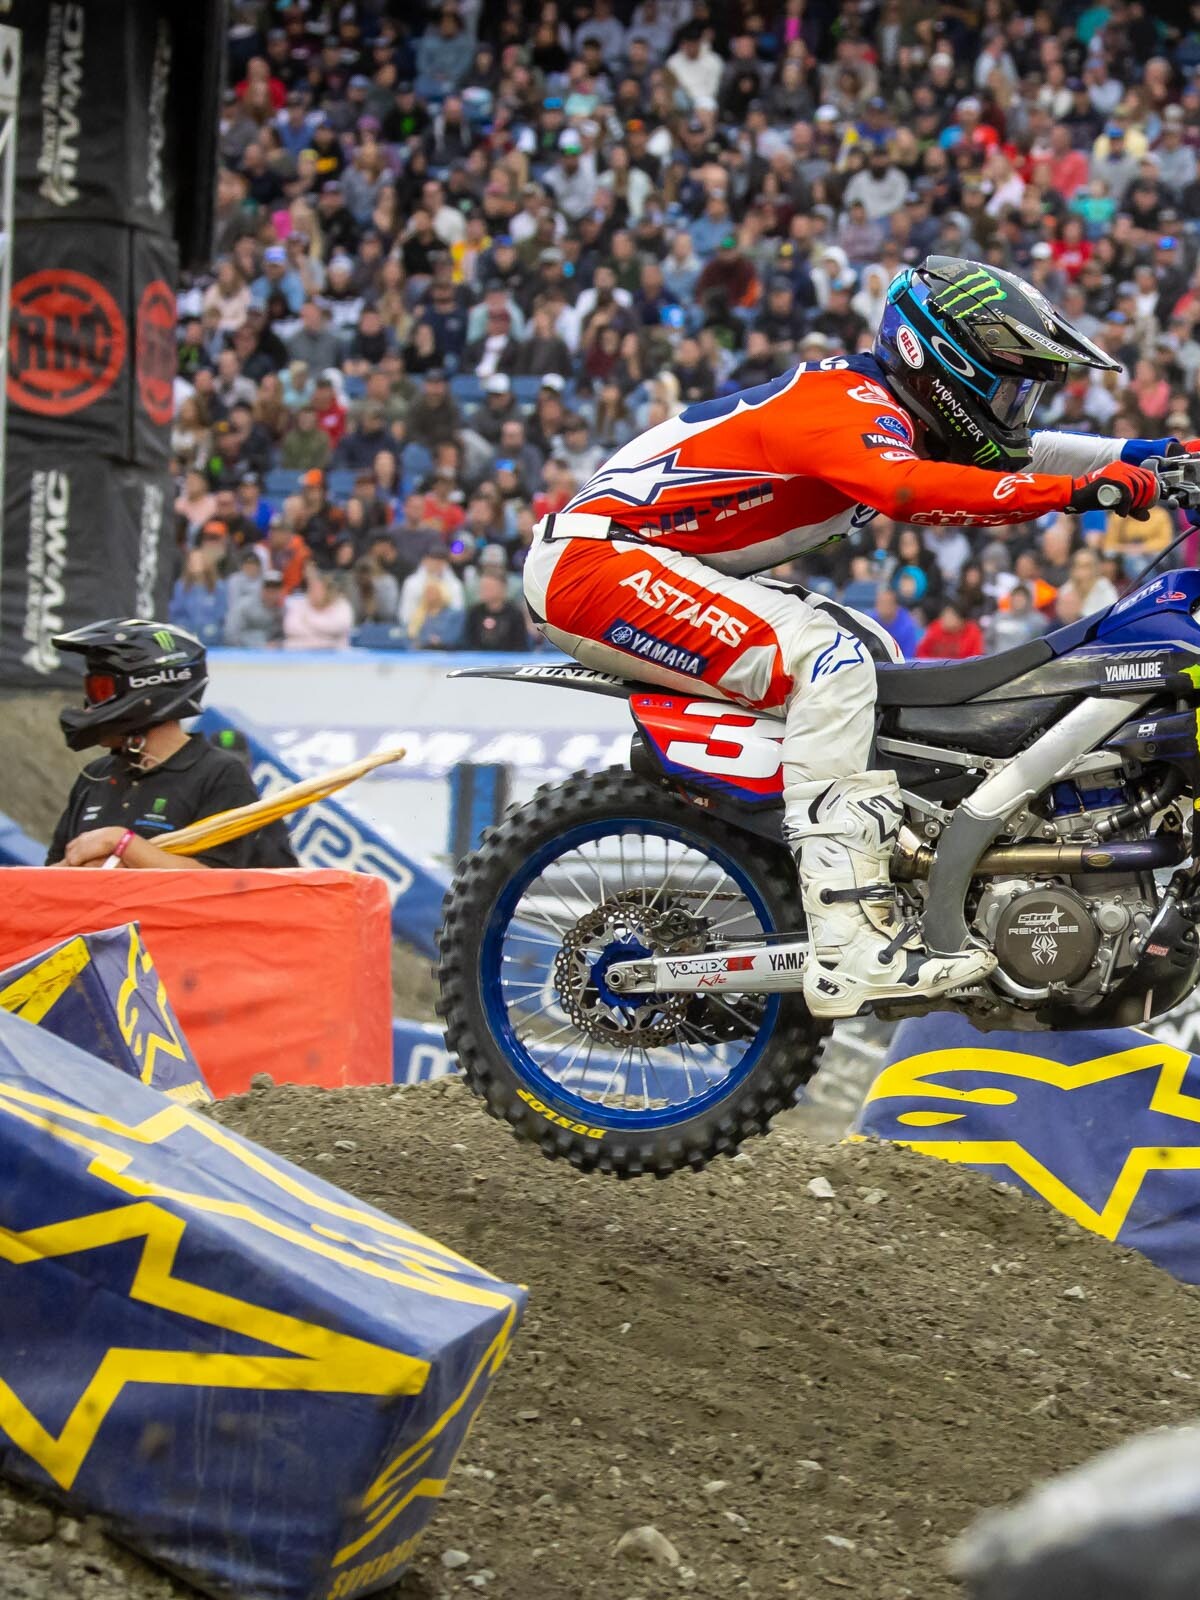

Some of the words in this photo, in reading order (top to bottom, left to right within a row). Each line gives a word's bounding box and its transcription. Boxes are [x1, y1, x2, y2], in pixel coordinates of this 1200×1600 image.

[899, 331, 919, 364] BELL
[931, 395, 967, 438] ENERGY
[618, 569, 749, 648] ASTARS
[630, 633, 700, 674] YAMAHA
[129, 667, 192, 688] bollé
[1104, 661, 1162, 683] YAMALUBE
[665, 702, 786, 780] 3
[1008, 925, 1079, 935] REKLUSE
[666, 958, 728, 978] VORTEX
[769, 952, 809, 971] YAMA
